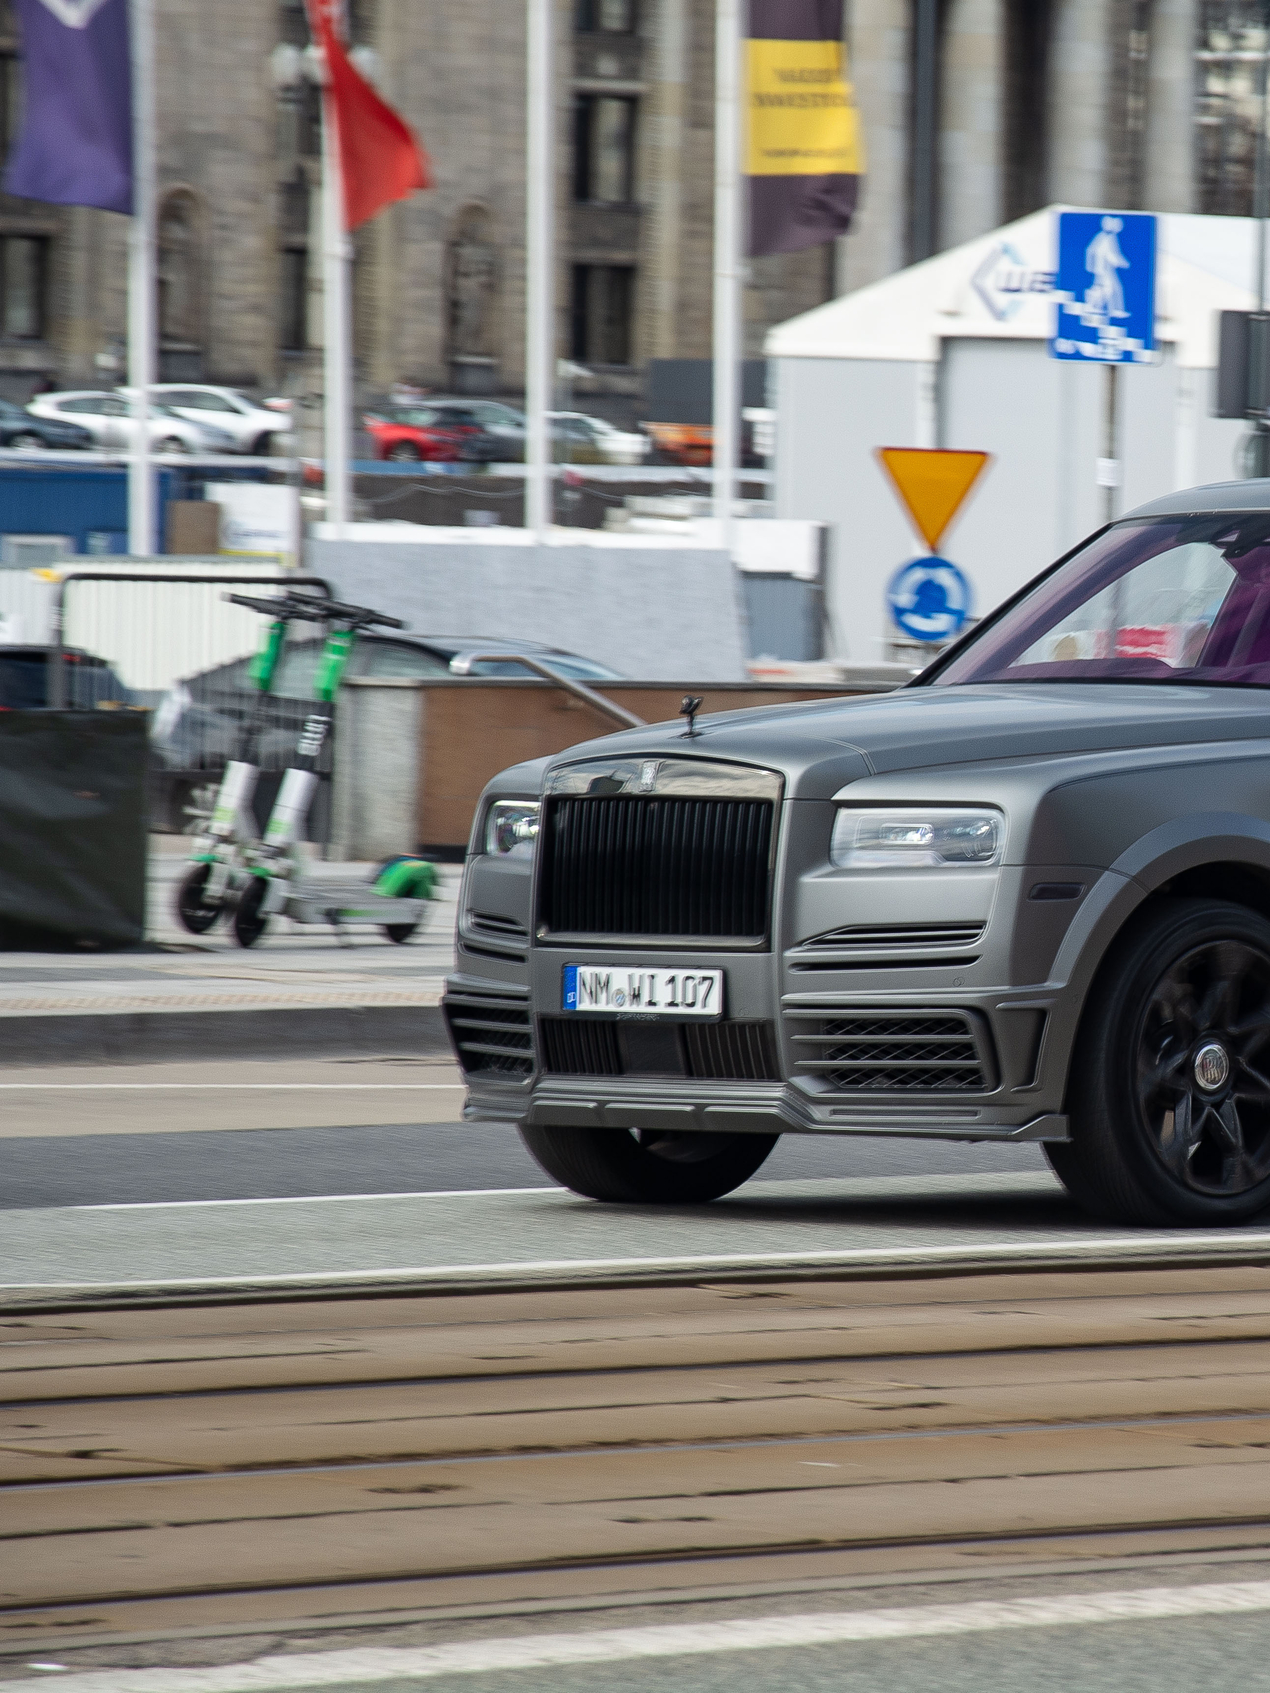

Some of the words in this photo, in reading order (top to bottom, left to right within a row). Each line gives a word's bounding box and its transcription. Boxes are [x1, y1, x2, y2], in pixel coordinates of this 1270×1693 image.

[578, 971, 611, 1006] NM
[628, 972, 658, 1007] WI
[664, 974, 714, 1010] 107
